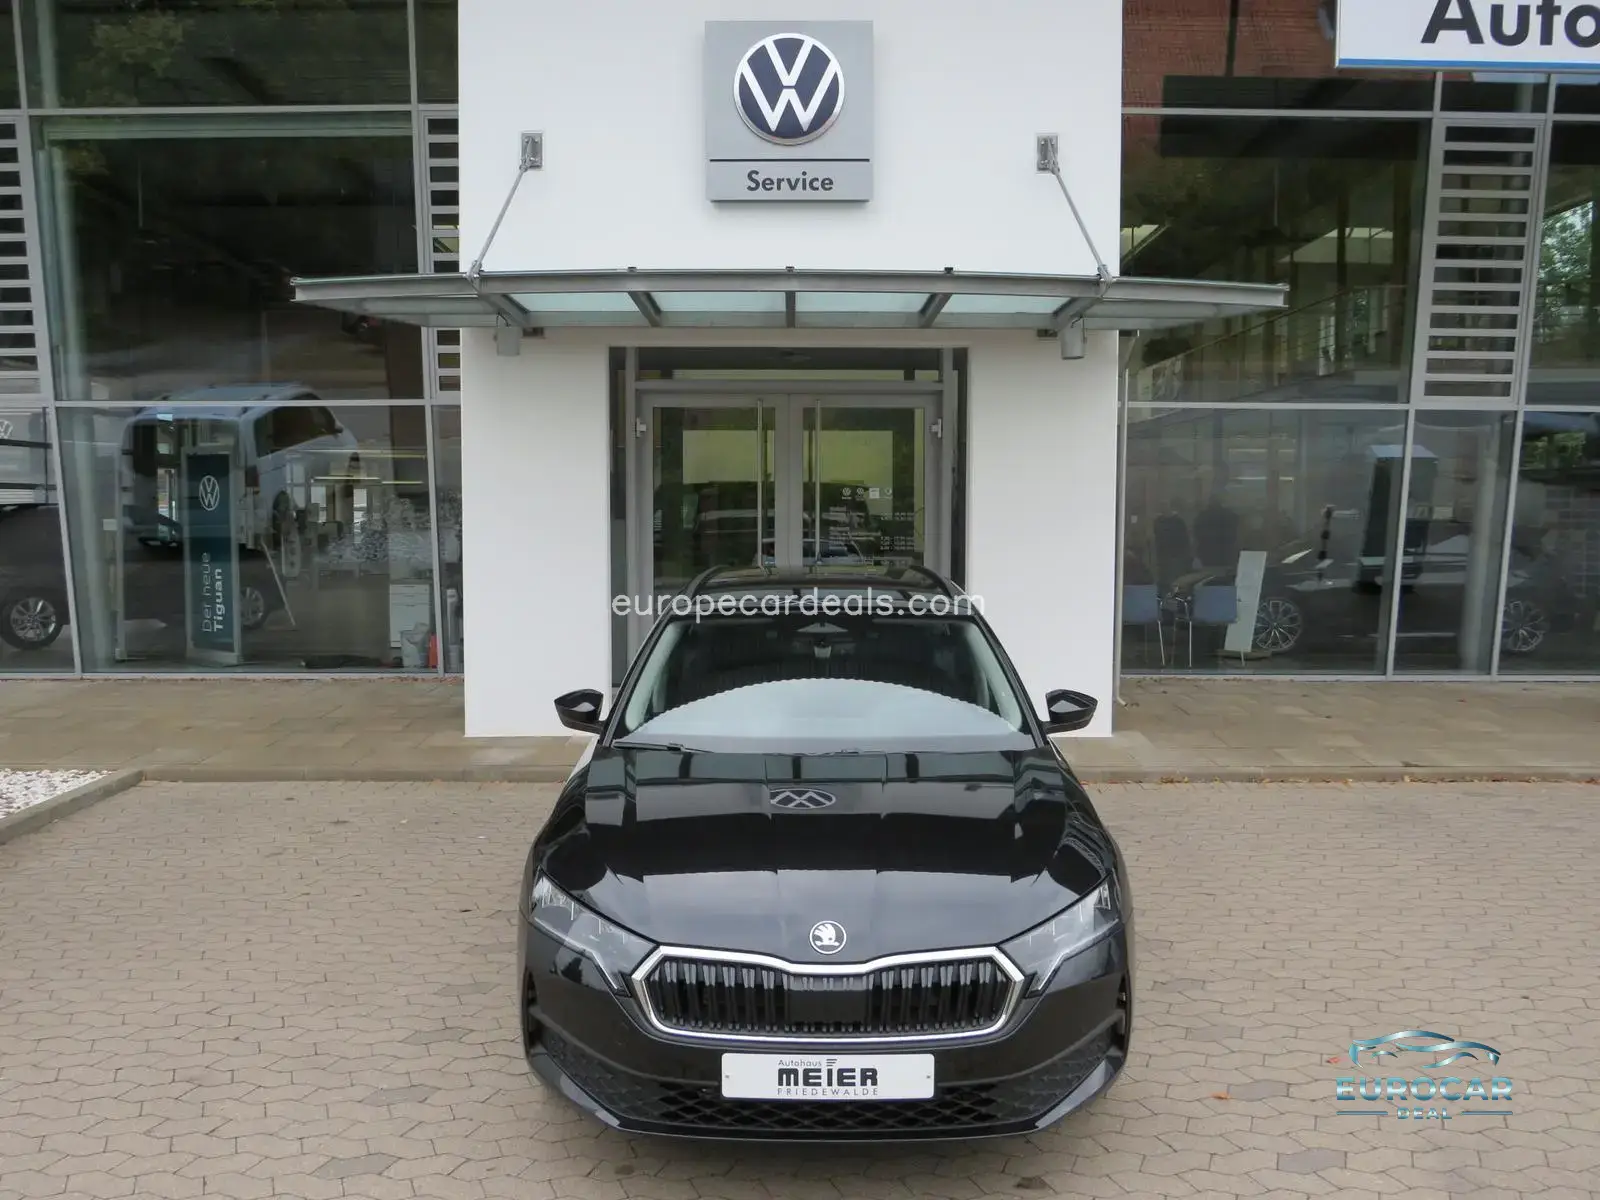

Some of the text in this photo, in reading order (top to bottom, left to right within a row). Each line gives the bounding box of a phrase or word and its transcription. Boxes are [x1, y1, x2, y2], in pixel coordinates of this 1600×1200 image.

[1421, 0, 1600, 47] Auto
[735, 34, 845, 145] VW
[746, 170, 834, 192] Service
[202, 552, 212, 632] Der neue
[213, 568, 225, 632] Tiguan
[778, 1059, 822, 1067] Autohaus
[778, 1067, 878, 1086] MEIER
[778, 1088, 878, 1096] FRIEDEWALDE
